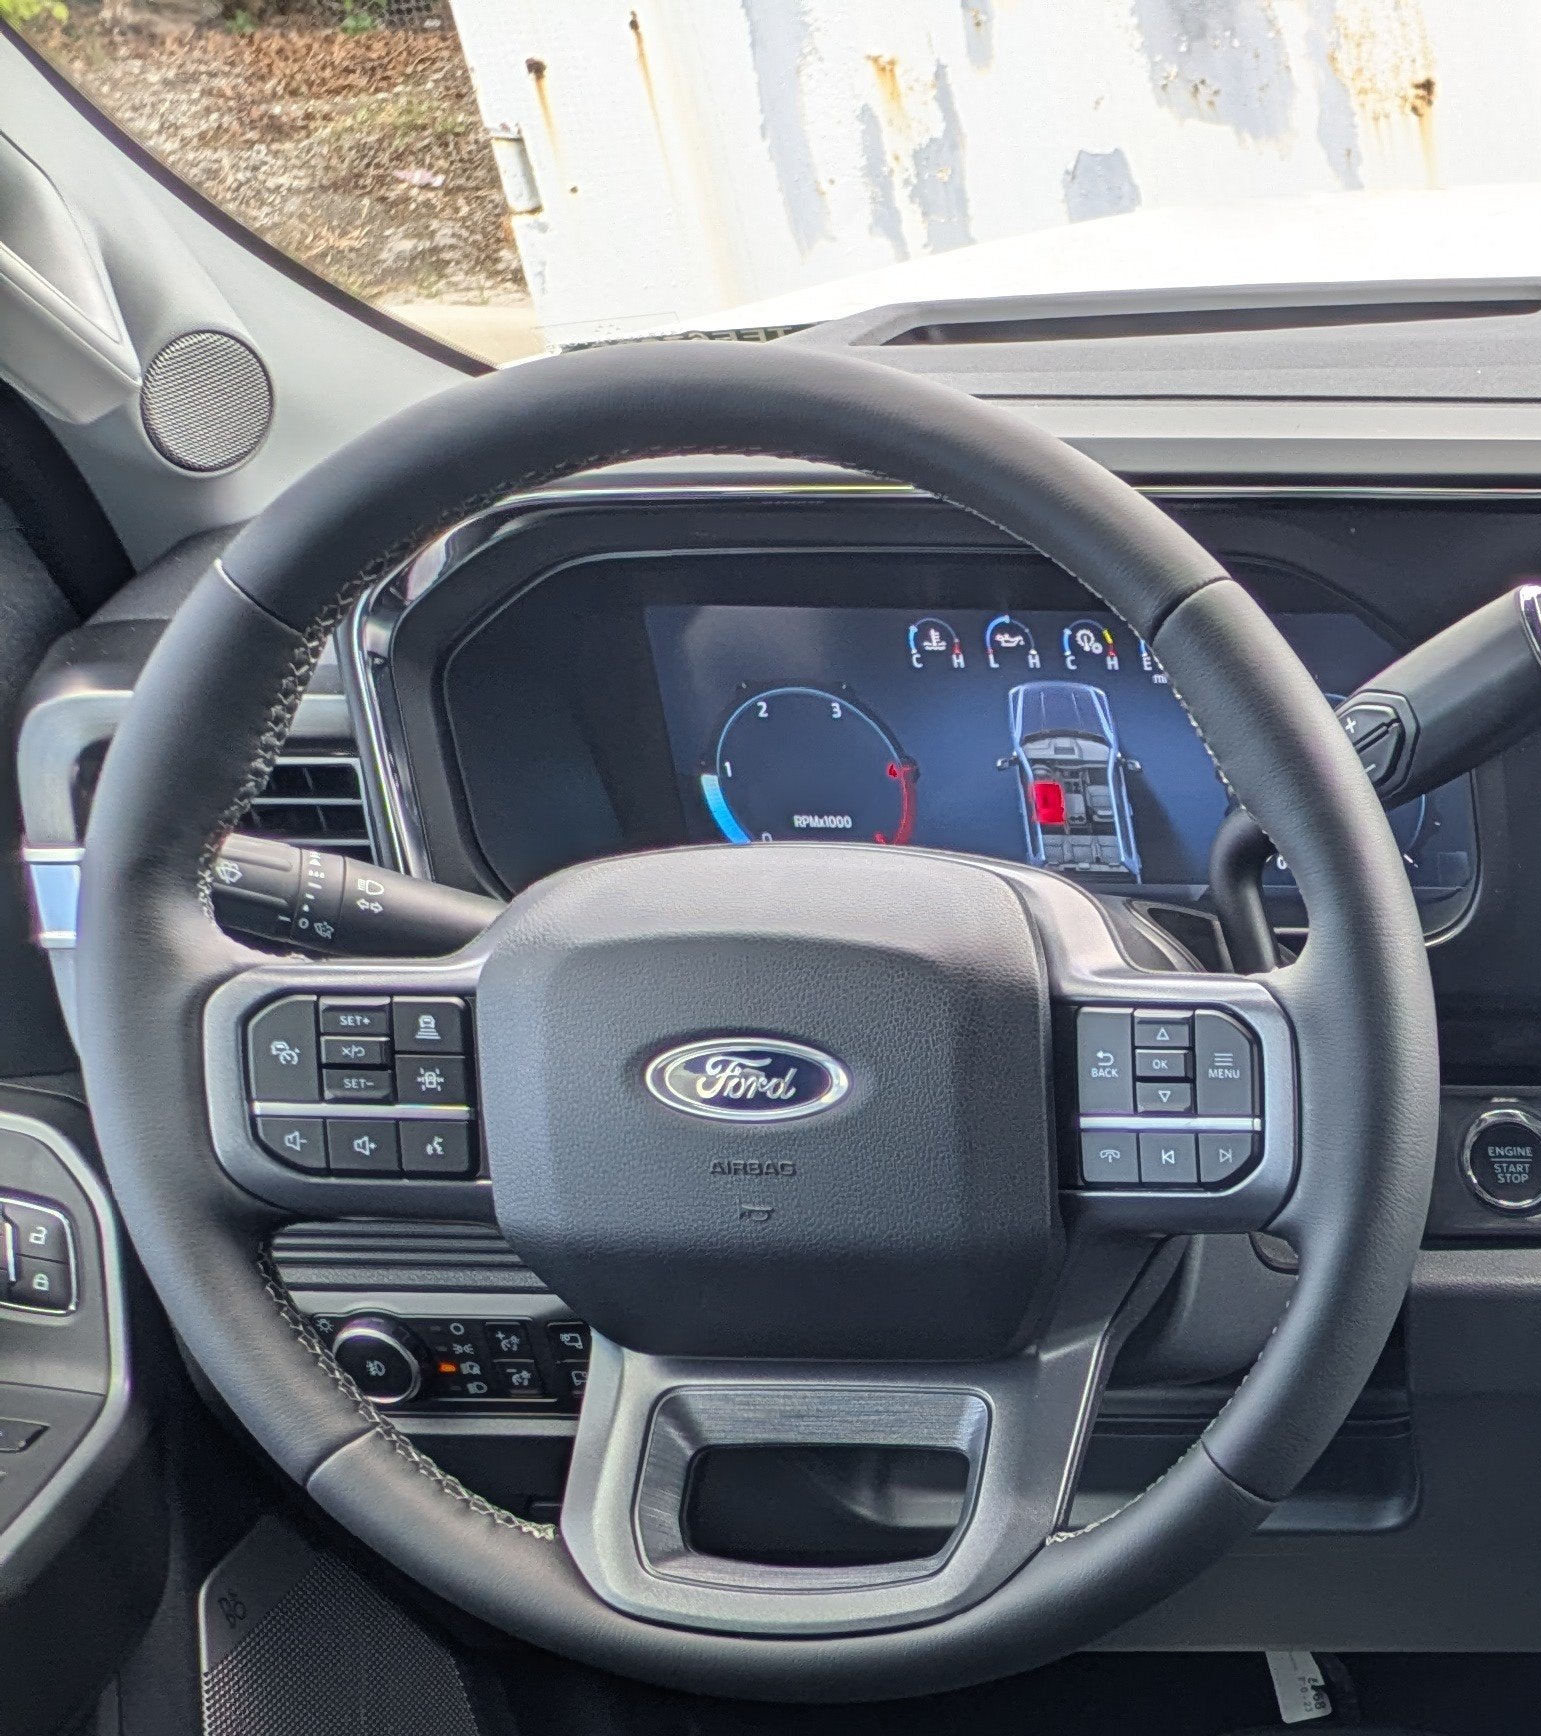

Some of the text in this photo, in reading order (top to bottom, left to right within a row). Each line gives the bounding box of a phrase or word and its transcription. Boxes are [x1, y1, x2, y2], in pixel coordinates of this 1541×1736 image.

[757, 702, 769, 718] 2
[831, 702, 842, 719] 3
[794, 815, 852, 829] RPMx1000
[1151, 1059, 1168, 1070] OK
[698, 1055, 797, 1101] Ford
[1090, 1067, 1119, 1079] BACK
[1207, 1068, 1240, 1080] MENU
[1487, 1146, 1533, 1157] ENGINE
[710, 1161, 797, 1177] AIRBAG
[1493, 1164, 1530, 1175] START
[1497, 1173, 1529, 1184] STOP
